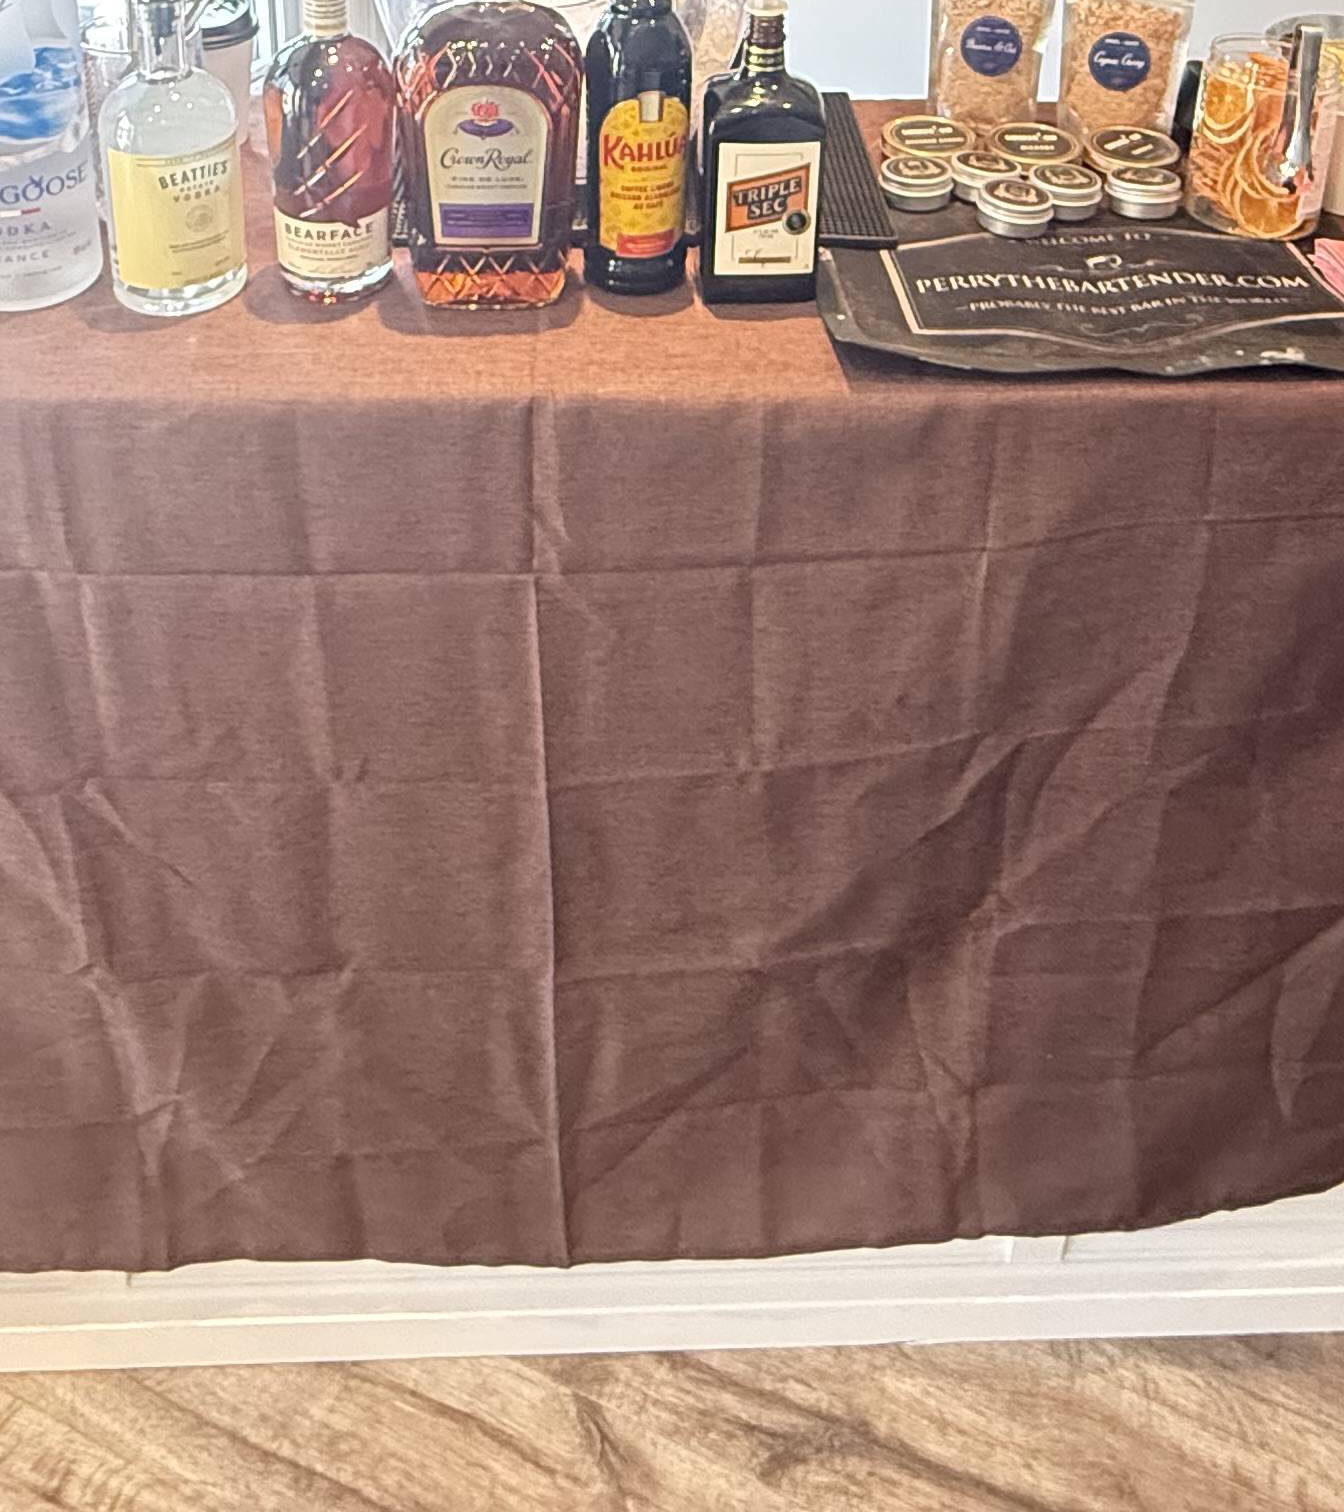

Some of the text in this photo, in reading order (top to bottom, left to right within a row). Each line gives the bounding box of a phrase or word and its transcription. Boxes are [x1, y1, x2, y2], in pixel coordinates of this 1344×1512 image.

[440, 147, 533, 171] Crown Royal
[0, 159, 88, 205] GOOSE
[734, 178, 801, 205] TRIPLE
[173, 185, 220, 203] VODKA
[750, 197, 785, 219] SEC
[284, 221, 375, 241] BEARFACE
[915, 272, 1310, 294] PERRYTHEBARTENDER.COM
[969, 300, 1050, 312] PROBABLY
[1130, 300, 1165, 312] BAR
